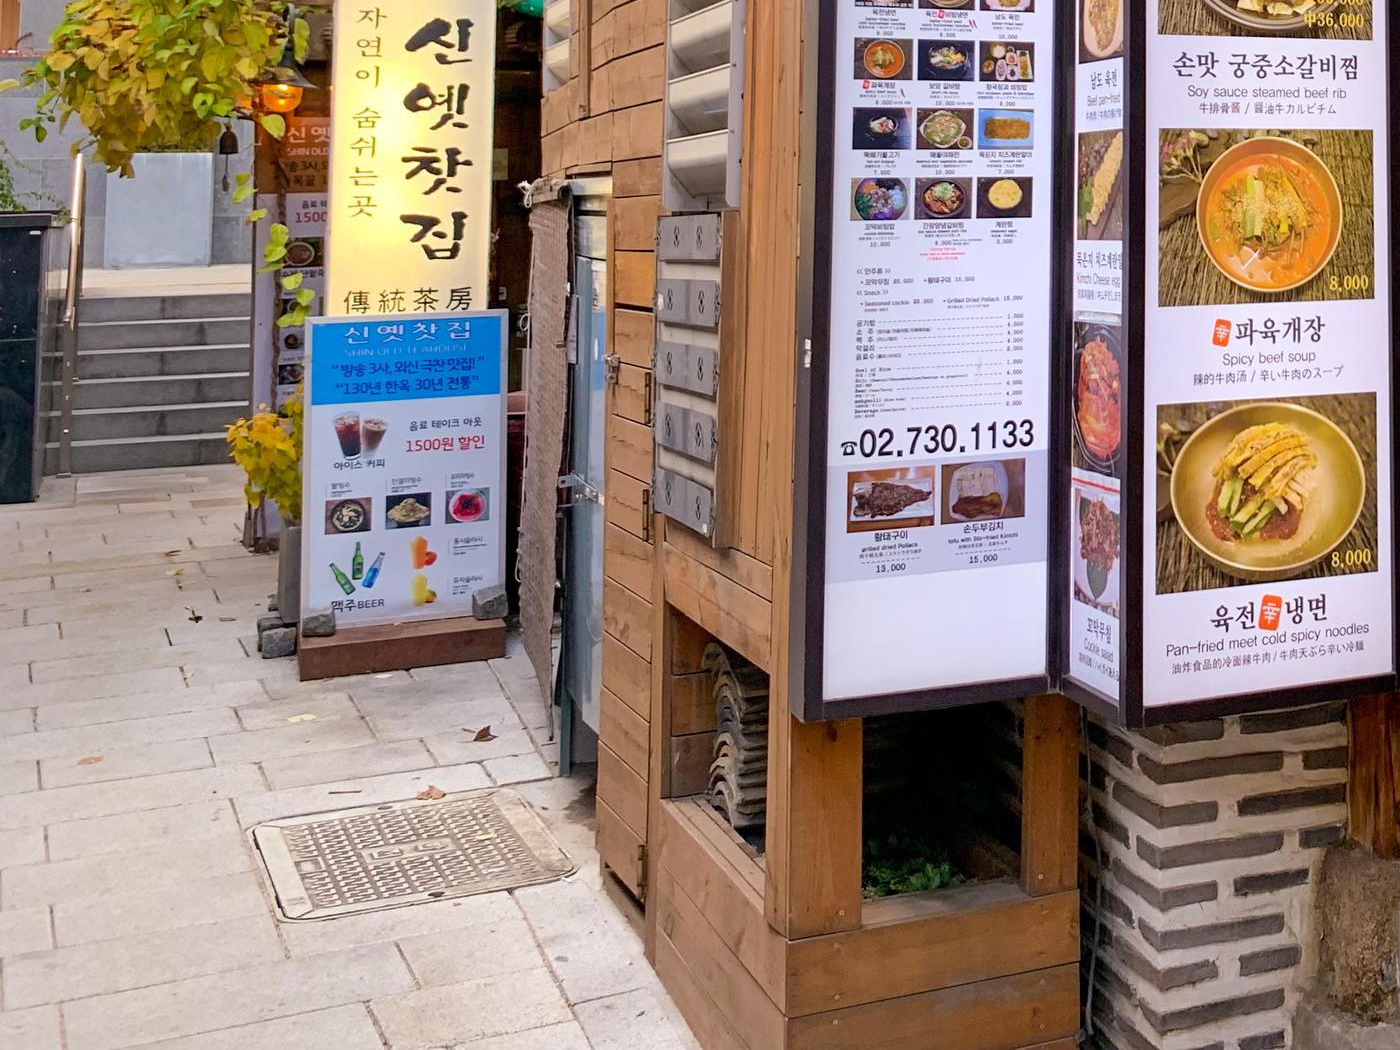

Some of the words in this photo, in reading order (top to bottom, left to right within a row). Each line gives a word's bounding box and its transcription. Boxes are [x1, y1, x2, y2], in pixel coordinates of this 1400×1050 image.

[356, 7, 387, 88] 자연이
[1172, 51, 1219, 79] 손맛
[1228, 53, 1358, 81] 궁중소갈비찜
[1090, 71, 1103, 90] 남도
[1105, 68, 1117, 88] 육전
[1187, 85, 1209, 99] Soy
[1213, 87, 1248, 98] sauce
[1252, 86, 1300, 98] steamed
[1304, 87, 1329, 98] beef
[1332, 87, 1347, 99] rib
[401, 17, 474, 260] 신옛찻집
[343, 286, 473, 315] 傳統茶房
[344, 322, 471, 344] 신옛찻집
[1235, 316, 1326, 346] 파육개장
[369, 362, 392, 375] 3사,
[394, 361, 418, 374] 외신
[421, 359, 446, 373] 극찬
[1222, 353, 1254, 367] Spicy
[1258, 351, 1284, 364] beef
[1288, 351, 1316, 364] soup
[385, 380, 410, 393] 한옥
[415, 378, 443, 391] 30년
[409, 421, 427, 431] 음료
[431, 418, 460, 429] 테이크
[463, 417, 482, 427] 아웃
[405, 437, 454, 453] 1500원
[458, 435, 485, 449] 할인
[859, 419, 1034, 458] 02.730.1133
[333, 461, 362, 470] 아이스
[366, 459, 385, 468] 커피
[963, 522, 1004, 534] 손두부김치
[874, 532, 908, 542] 황태구이
[969, 554, 998, 564] 15.000
[876, 563, 906, 573] 13.000
[1166, 638, 1224, 657] Pan-fried
[1229, 635, 1258, 650] meet
[1262, 631, 1287, 646] cold
[1291, 627, 1321, 644] spicy
[1325, 622, 1370, 638] noodles
